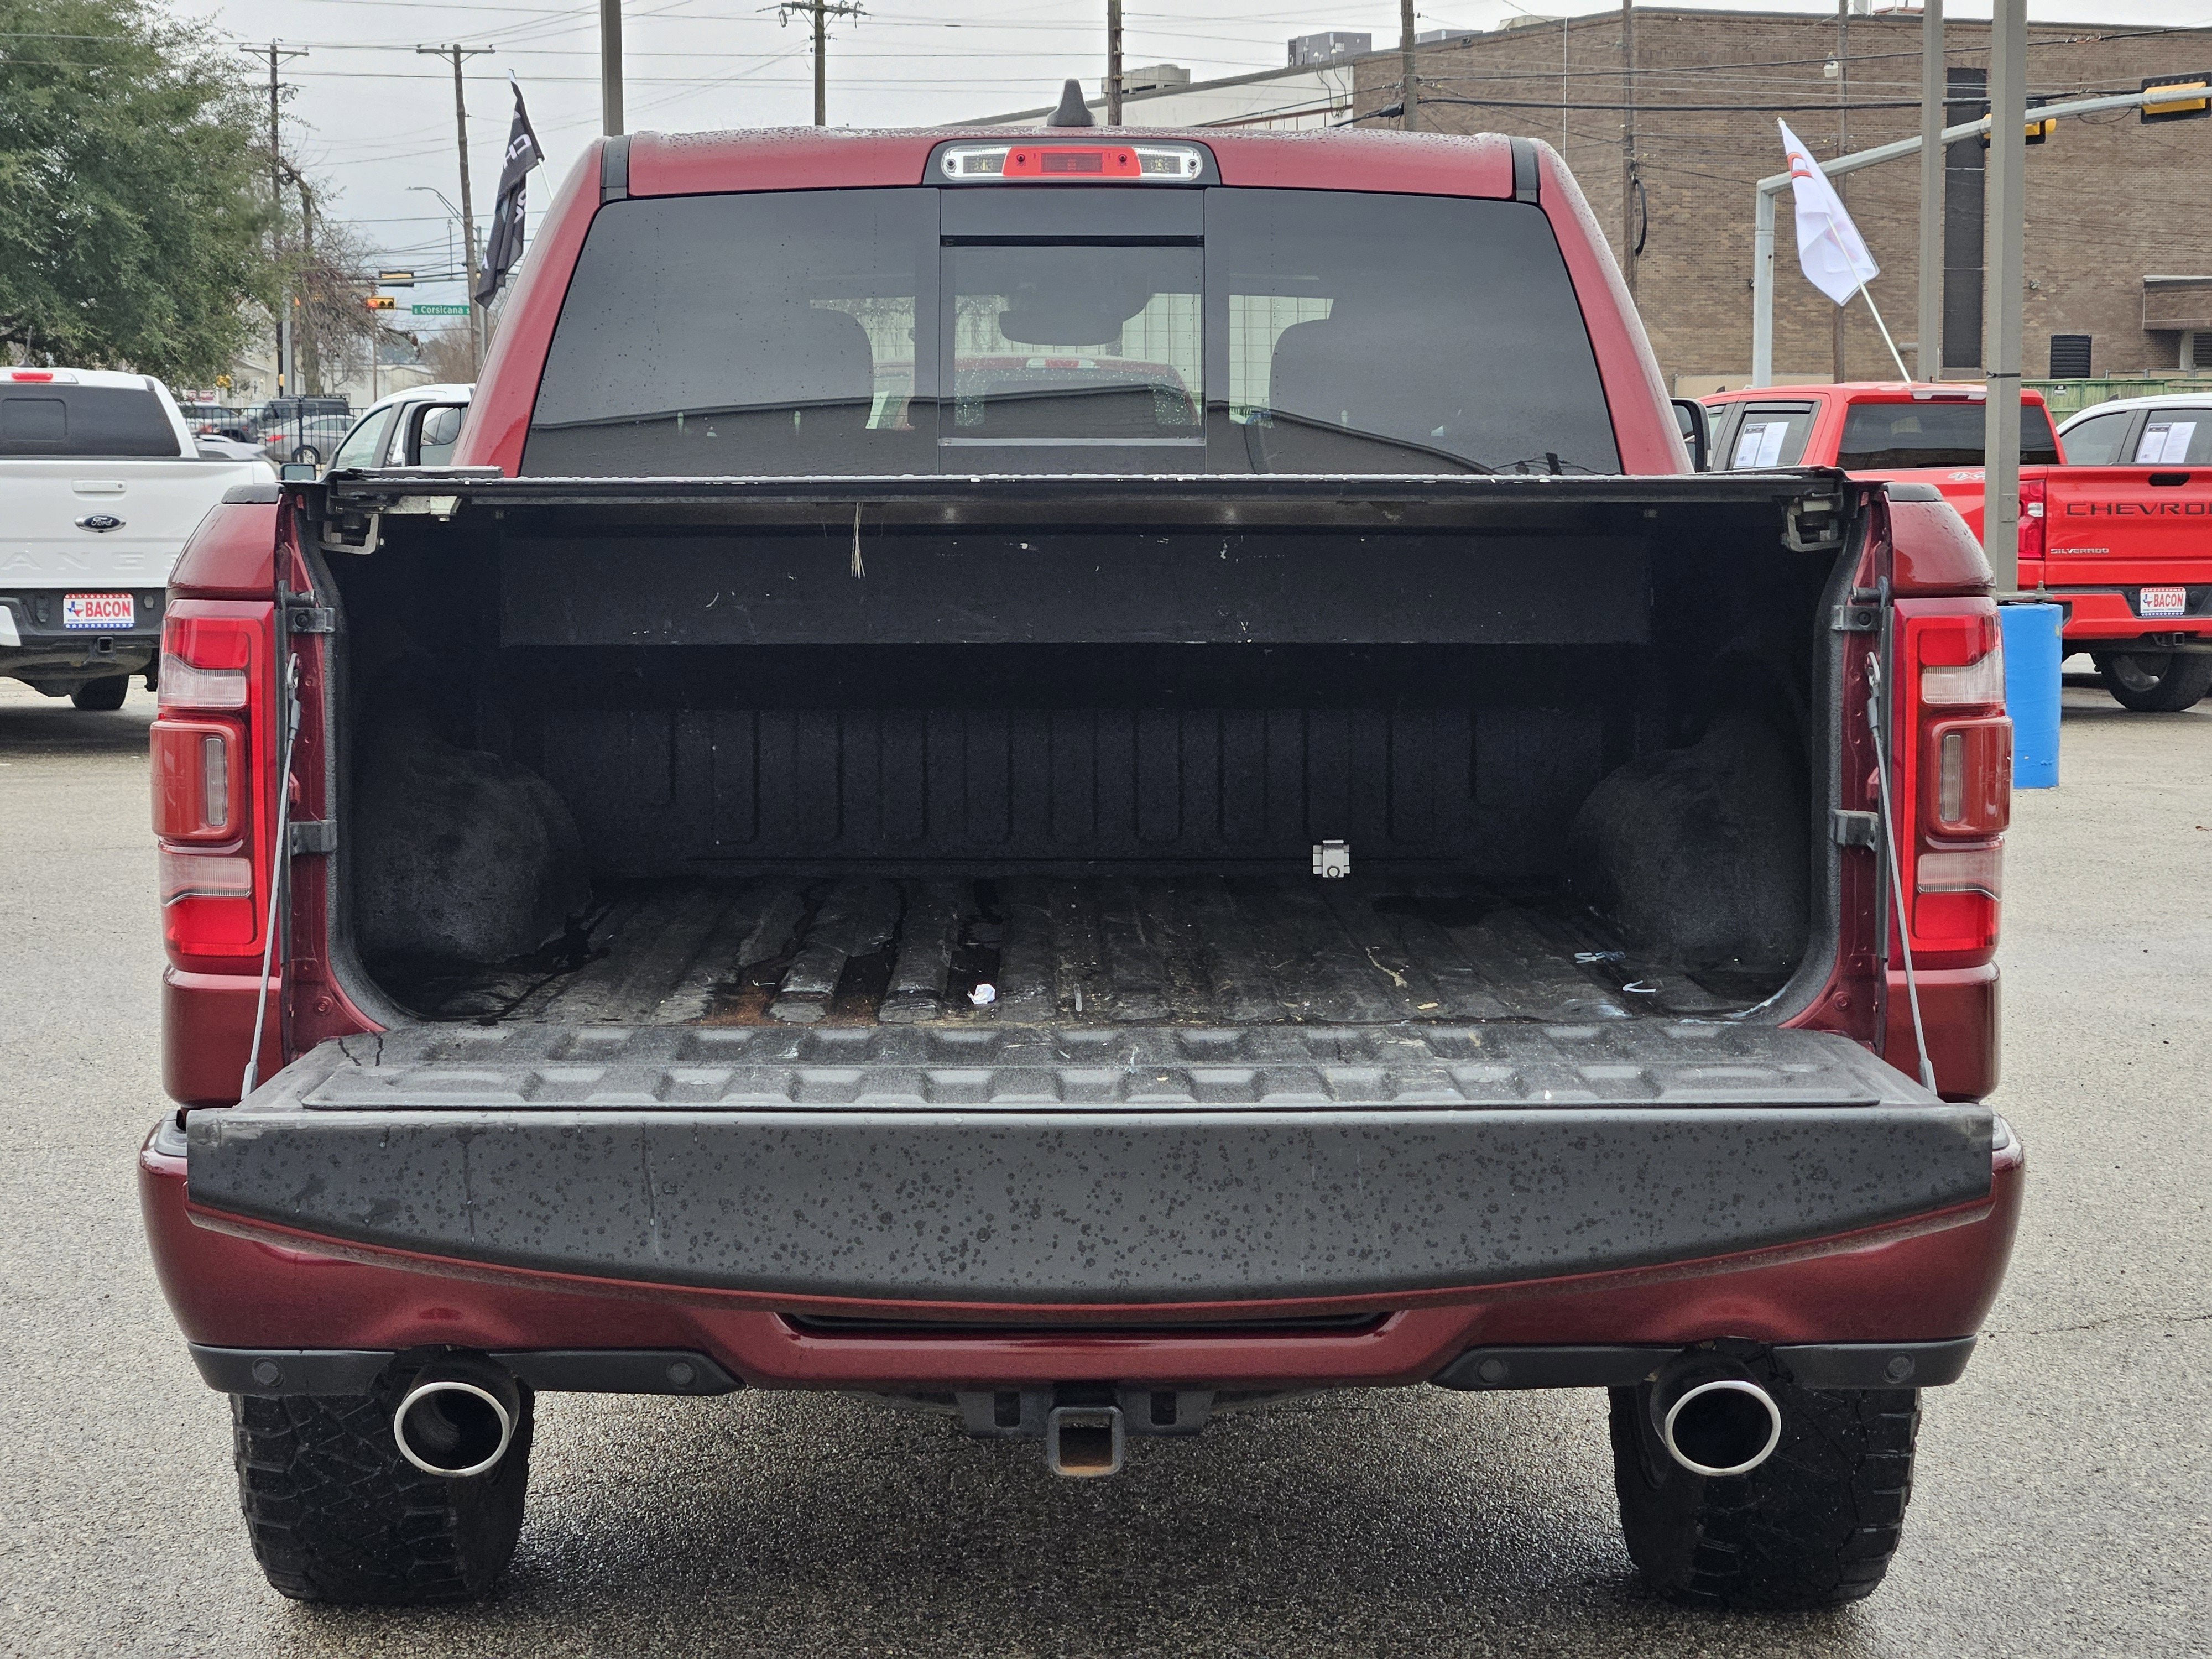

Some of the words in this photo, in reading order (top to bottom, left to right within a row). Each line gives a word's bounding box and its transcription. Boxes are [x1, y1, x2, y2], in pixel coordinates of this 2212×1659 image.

[2067, 503, 2212, 515] CHEVRO
[91, 517, 113, 526] Ford
[2154, 593, 2183, 607] BACON
[85, 601, 131, 617] BACON
